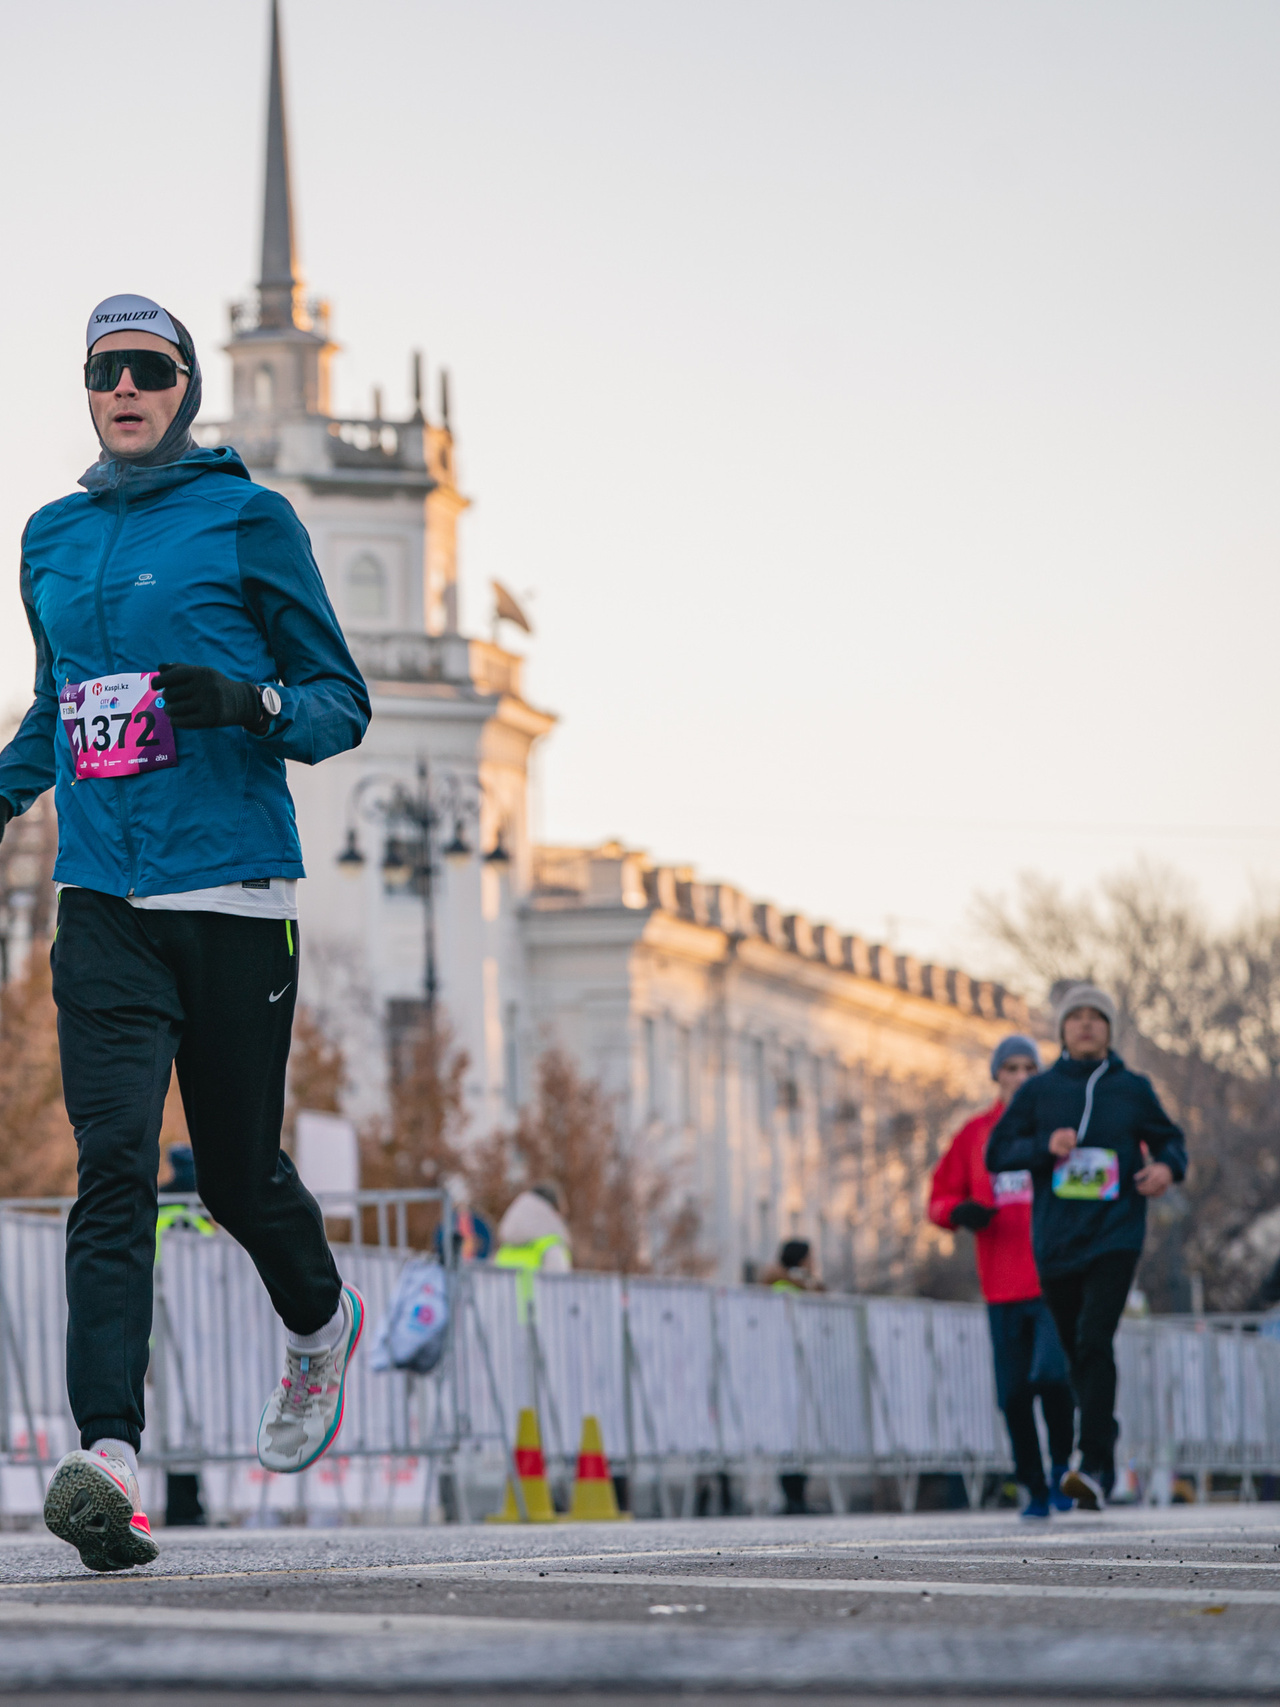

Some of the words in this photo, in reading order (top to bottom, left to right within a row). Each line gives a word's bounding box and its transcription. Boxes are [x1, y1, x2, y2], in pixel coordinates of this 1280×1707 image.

[94, 310, 159, 323] SPECIALIZED
[104, 683, 129, 692] Kaspi.kz
[74, 710, 160, 753] 1372
